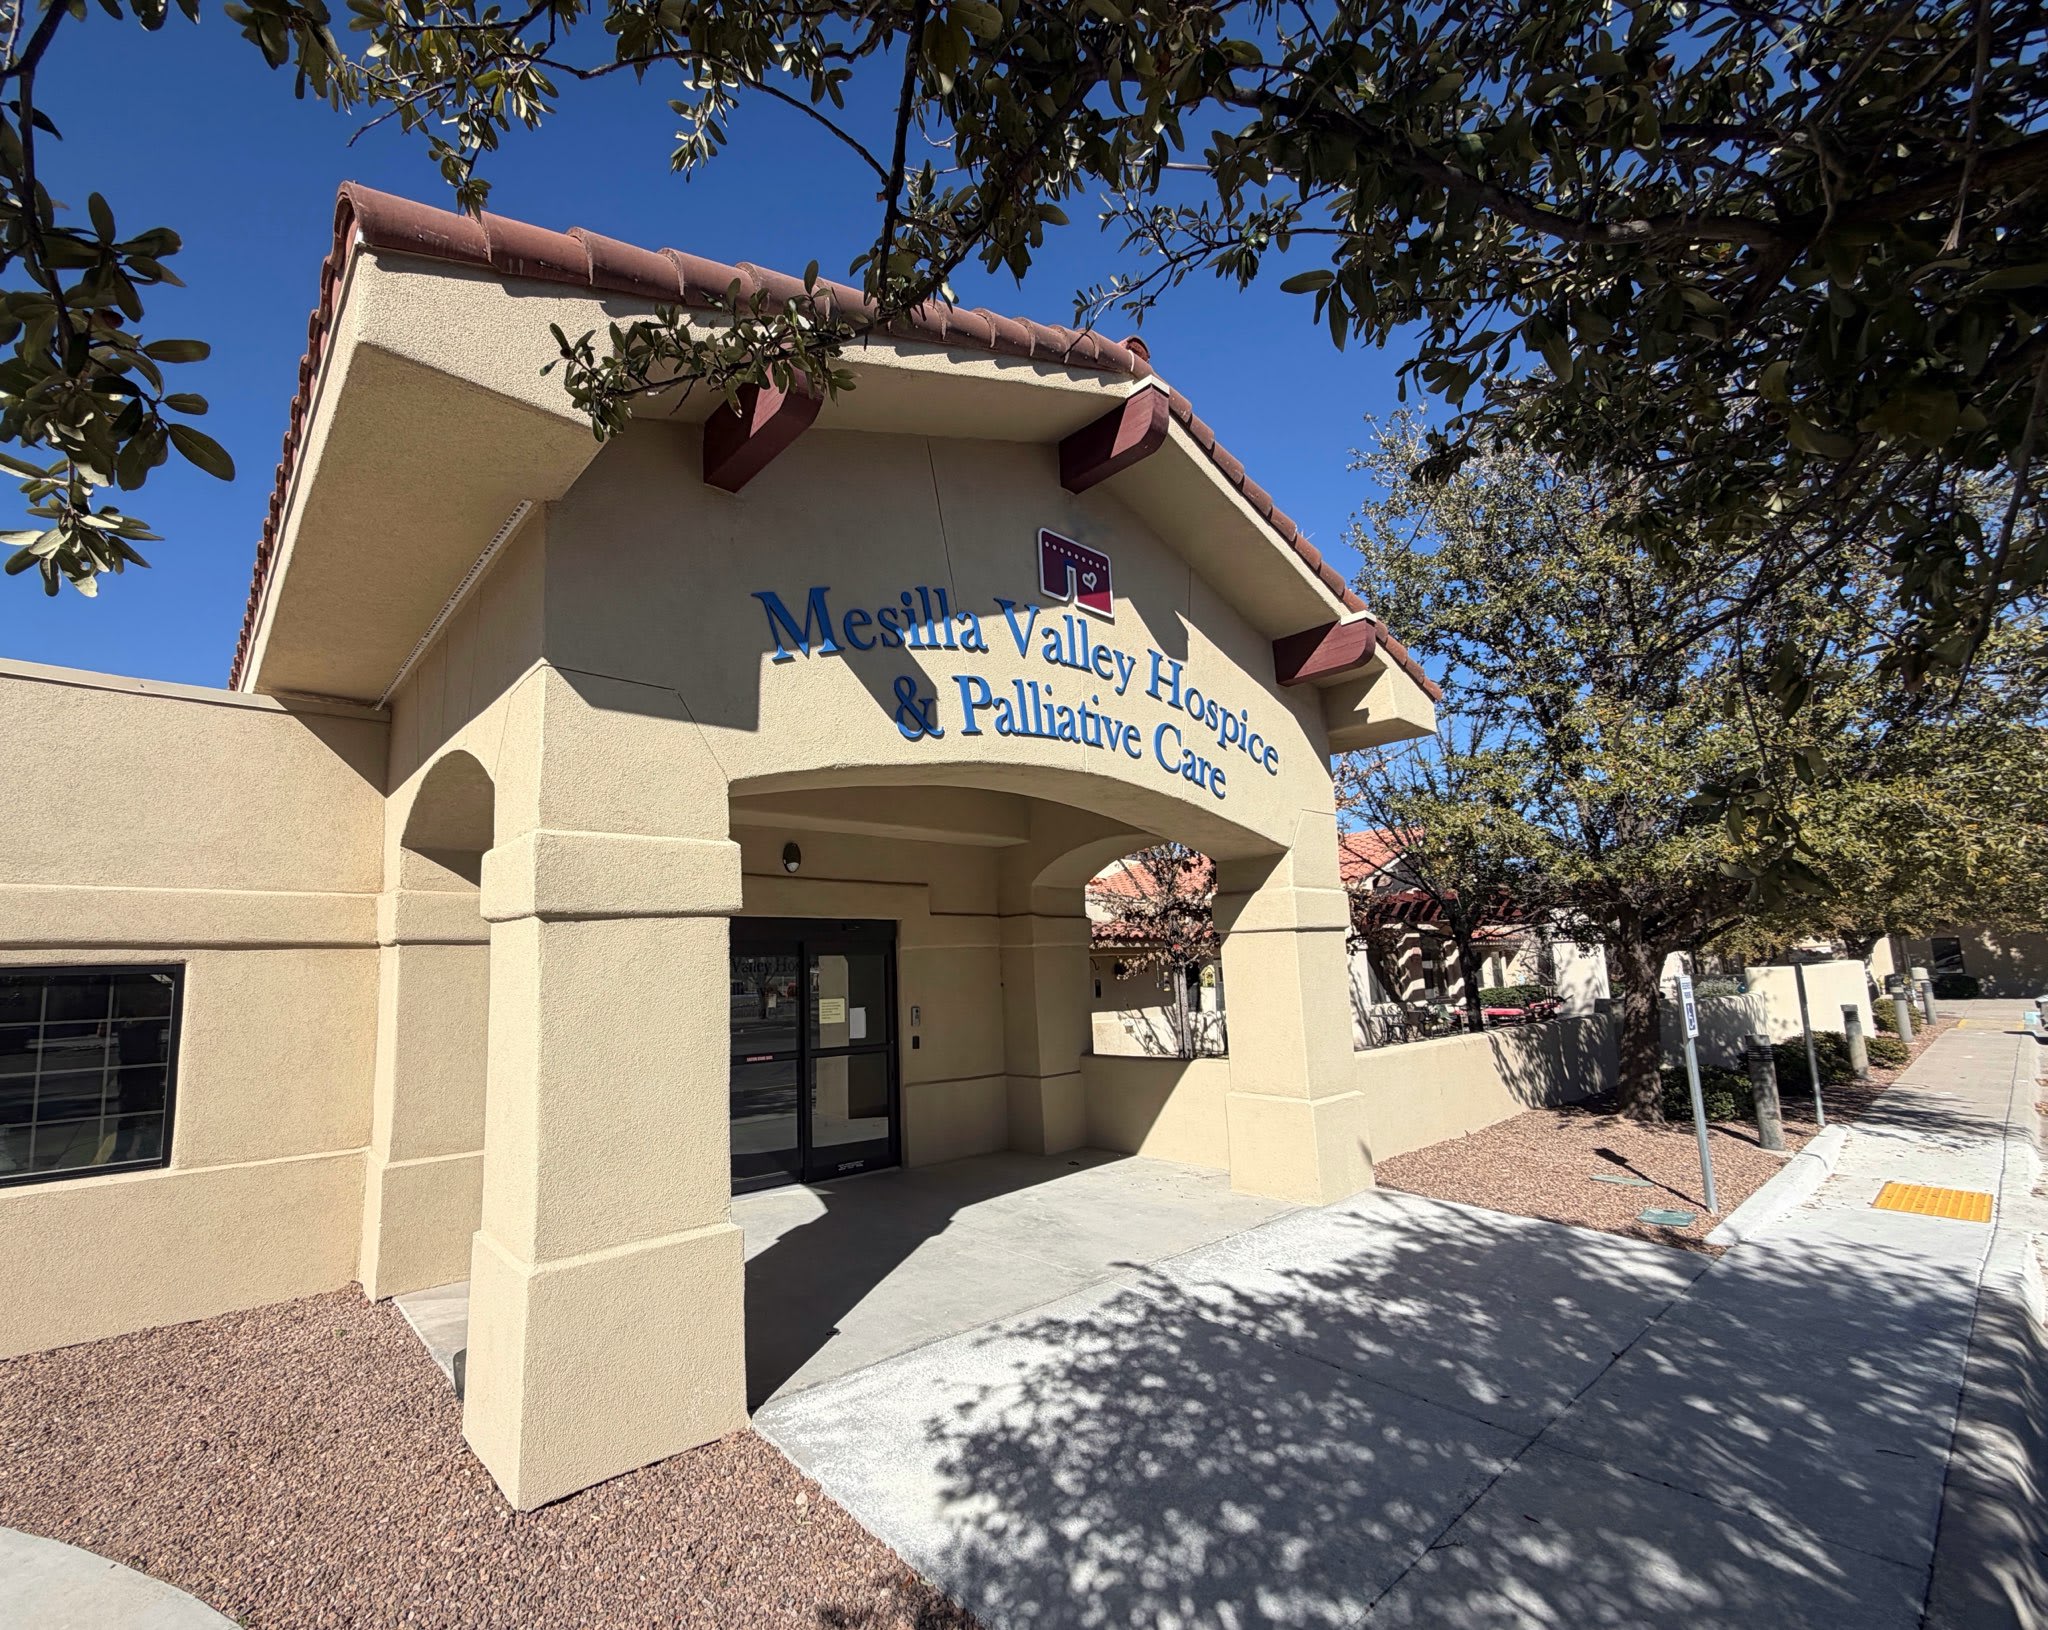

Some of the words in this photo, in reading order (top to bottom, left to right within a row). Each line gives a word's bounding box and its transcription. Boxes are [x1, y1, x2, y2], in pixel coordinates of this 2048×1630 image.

[751, 585, 989, 662] Mesilla
[993, 597, 1136, 696] Valley
[1145, 648, 1279, 776] Hospice
[893, 675, 945, 741] &
[952, 674, 1142, 759] Palliative
[1153, 722, 1226, 800] Care
